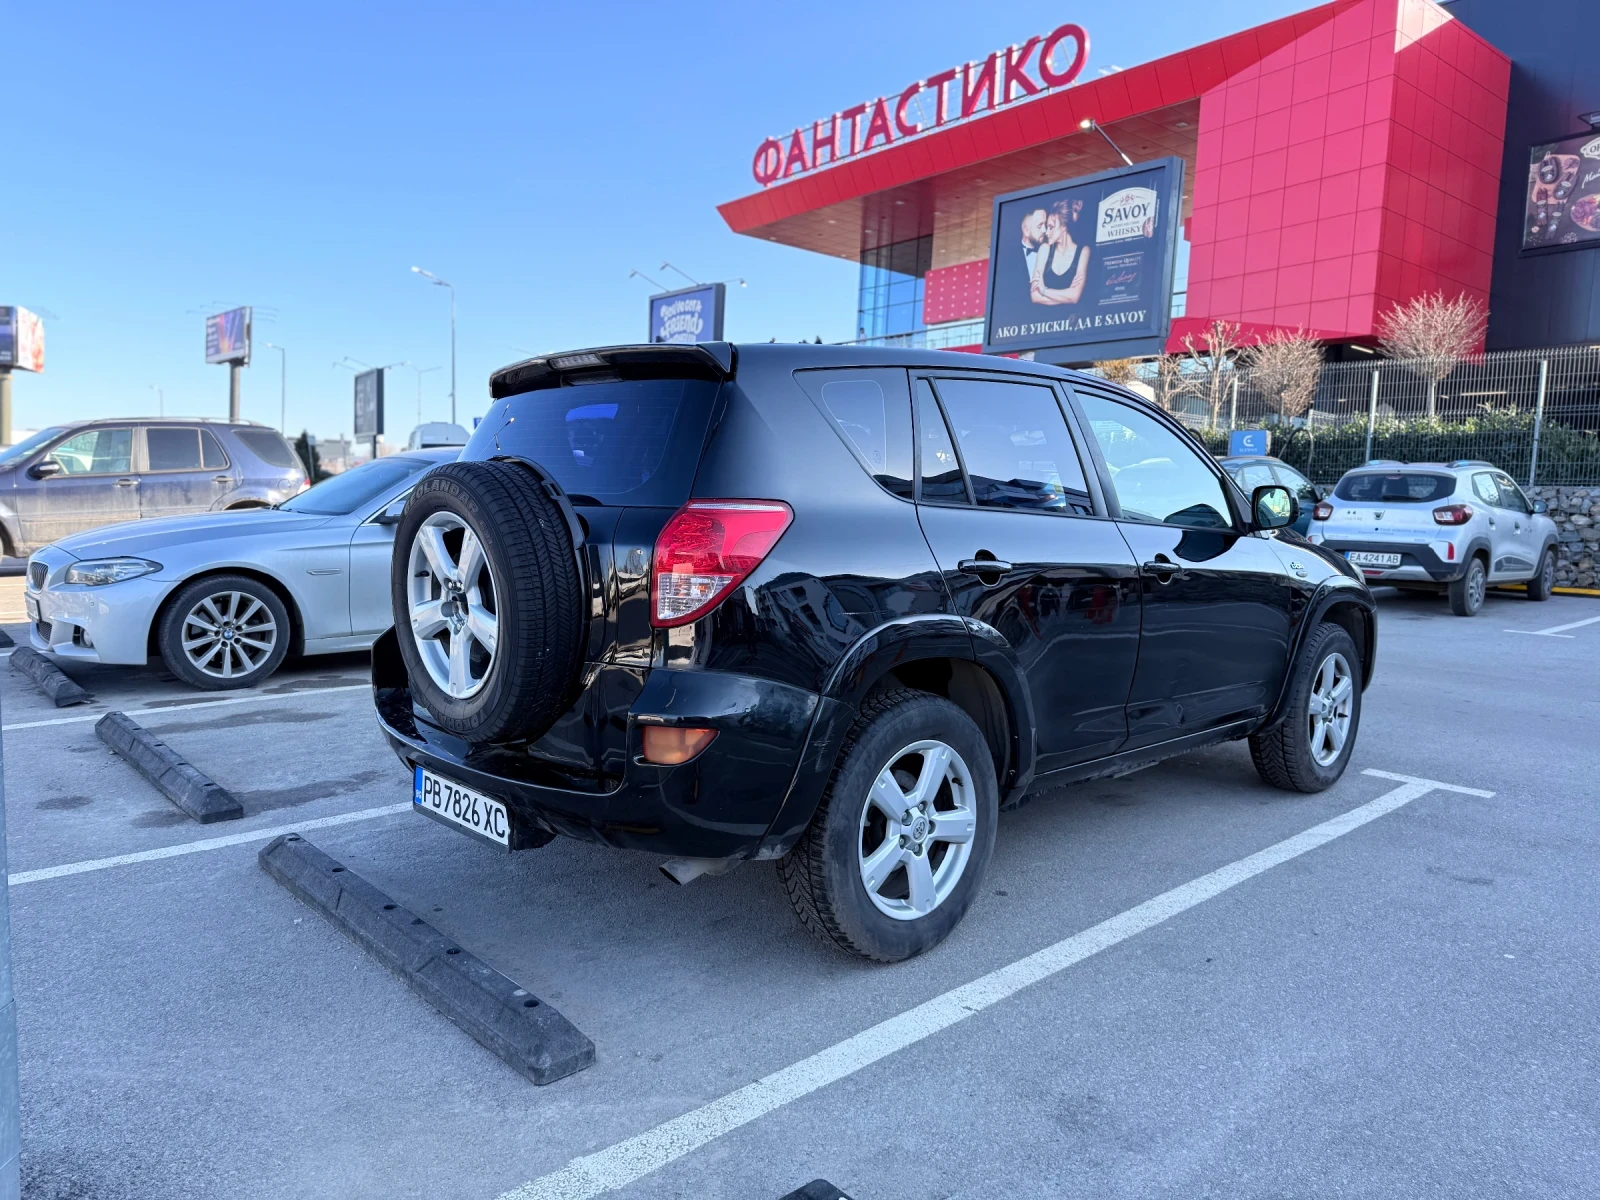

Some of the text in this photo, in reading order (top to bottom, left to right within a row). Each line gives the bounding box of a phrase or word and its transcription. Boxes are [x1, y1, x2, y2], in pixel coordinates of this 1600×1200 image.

[752, 23, 1091, 188] ФАНТАСТИКО
[1102, 202, 1150, 228] SAVOY
[1107, 225, 1142, 238] WHISKY
[996, 325, 1019, 338] АКО
[1020, 324, 1028, 336] Е
[1074, 317, 1092, 331] ДА
[1094, 315, 1102, 327] Е
[1104, 310, 1147, 326] SAVOY
[1363, 553, 1385, 562] 4241
[423, 775, 505, 839] PB 7826 XC
